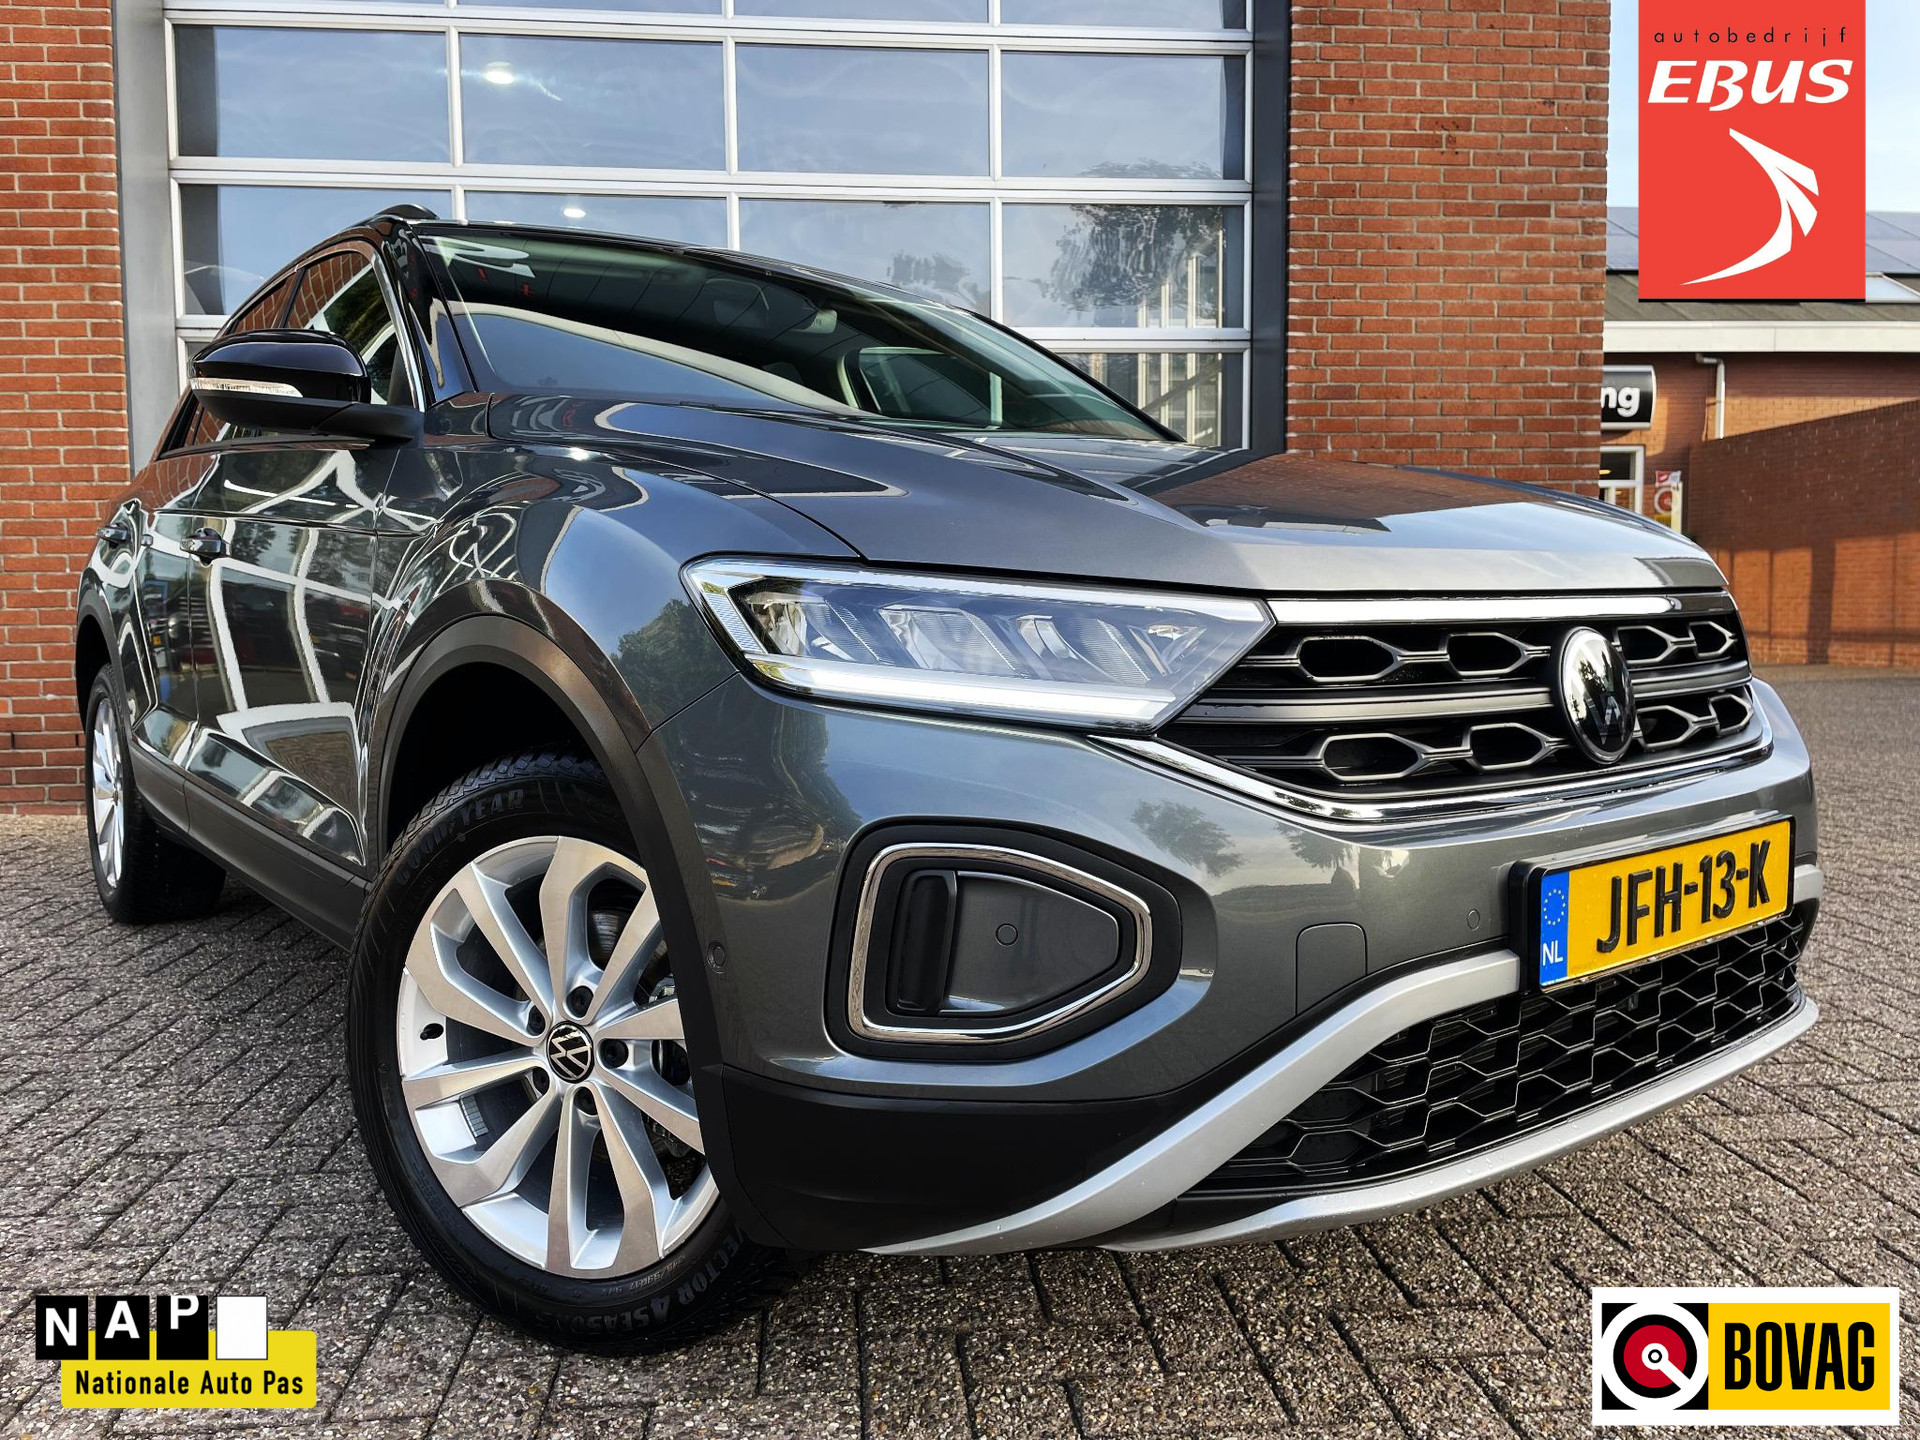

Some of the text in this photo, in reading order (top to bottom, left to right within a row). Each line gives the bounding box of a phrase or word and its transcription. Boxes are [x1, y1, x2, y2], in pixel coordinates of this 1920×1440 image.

[394, 788, 525, 885] GOODYEAR
[1597, 840, 1770, 953] JFH-13-K
[1542, 940, 1563, 966] NL
[678, 1220, 744, 1305] VECTOR
